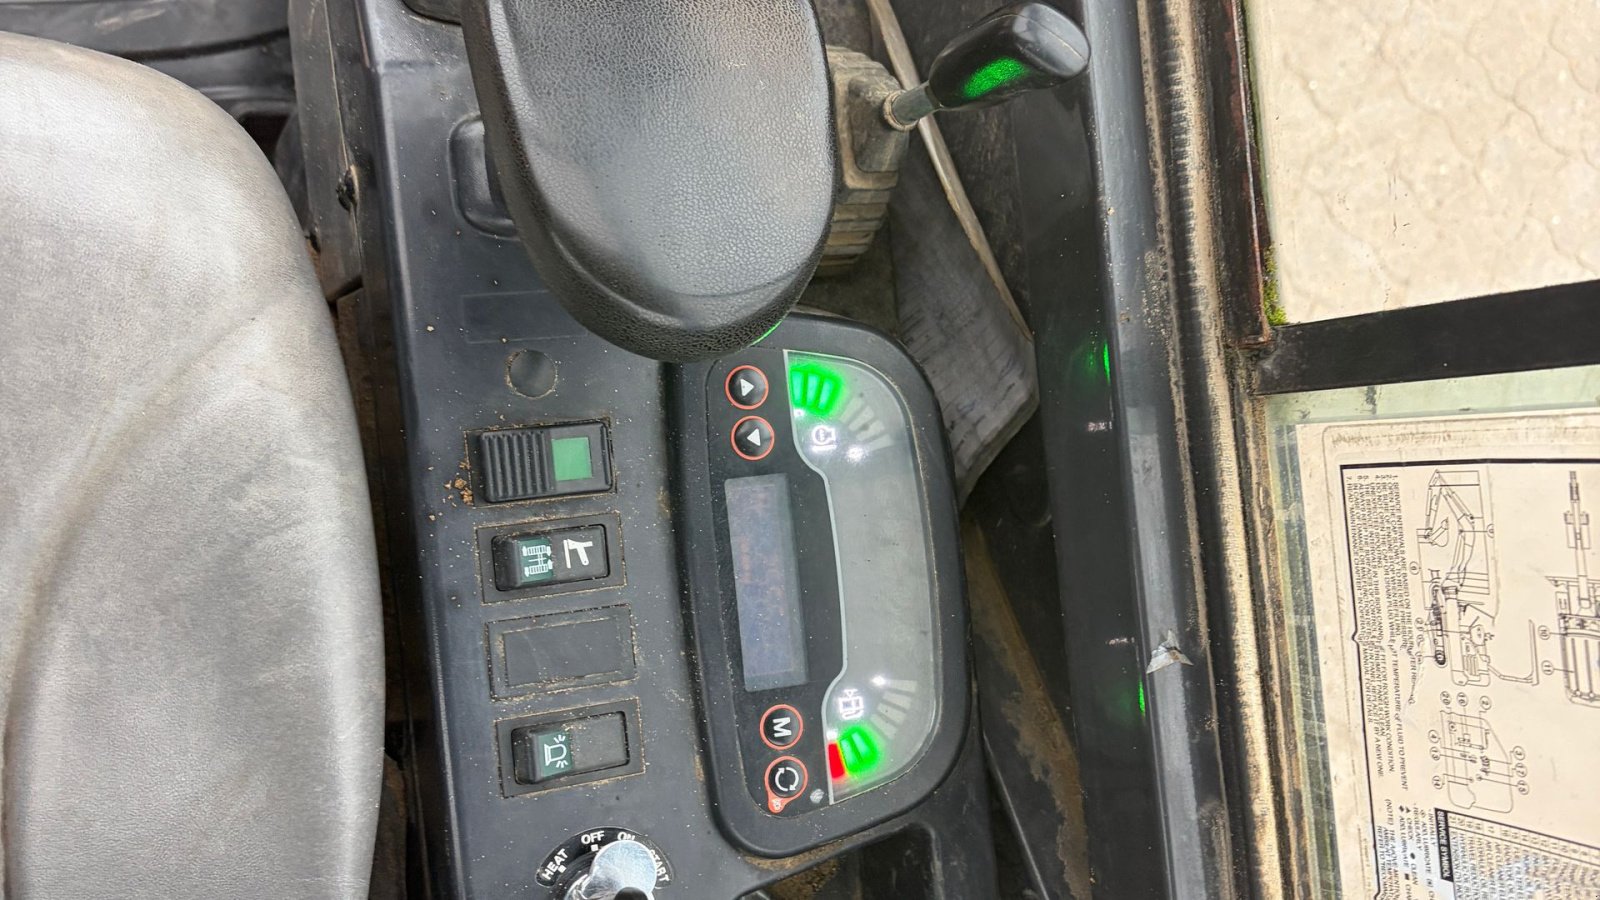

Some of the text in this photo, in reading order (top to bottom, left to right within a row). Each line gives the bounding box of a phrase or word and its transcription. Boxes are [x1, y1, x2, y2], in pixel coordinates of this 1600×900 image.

[1394, 482, 1402, 512] SERVICE
[1397, 515, 1406, 554] INTERVALS
[1405, 598, 1411, 609] ON
[1392, 660, 1401, 712] TEMPERATURE
[772, 717, 792, 738] M
[1396, 724, 1404, 744] FLUID
[1398, 747, 1404, 756] TO
[1400, 758, 1408, 791] PREVENT
[1384, 799, 1394, 826] (NOTE)
[581, 830, 604, 844] OFF
[617, 832, 636, 842] ON
[1437, 810, 1450, 878] SERVICE SYMBOL
[542, 848, 568, 880] HEAT
